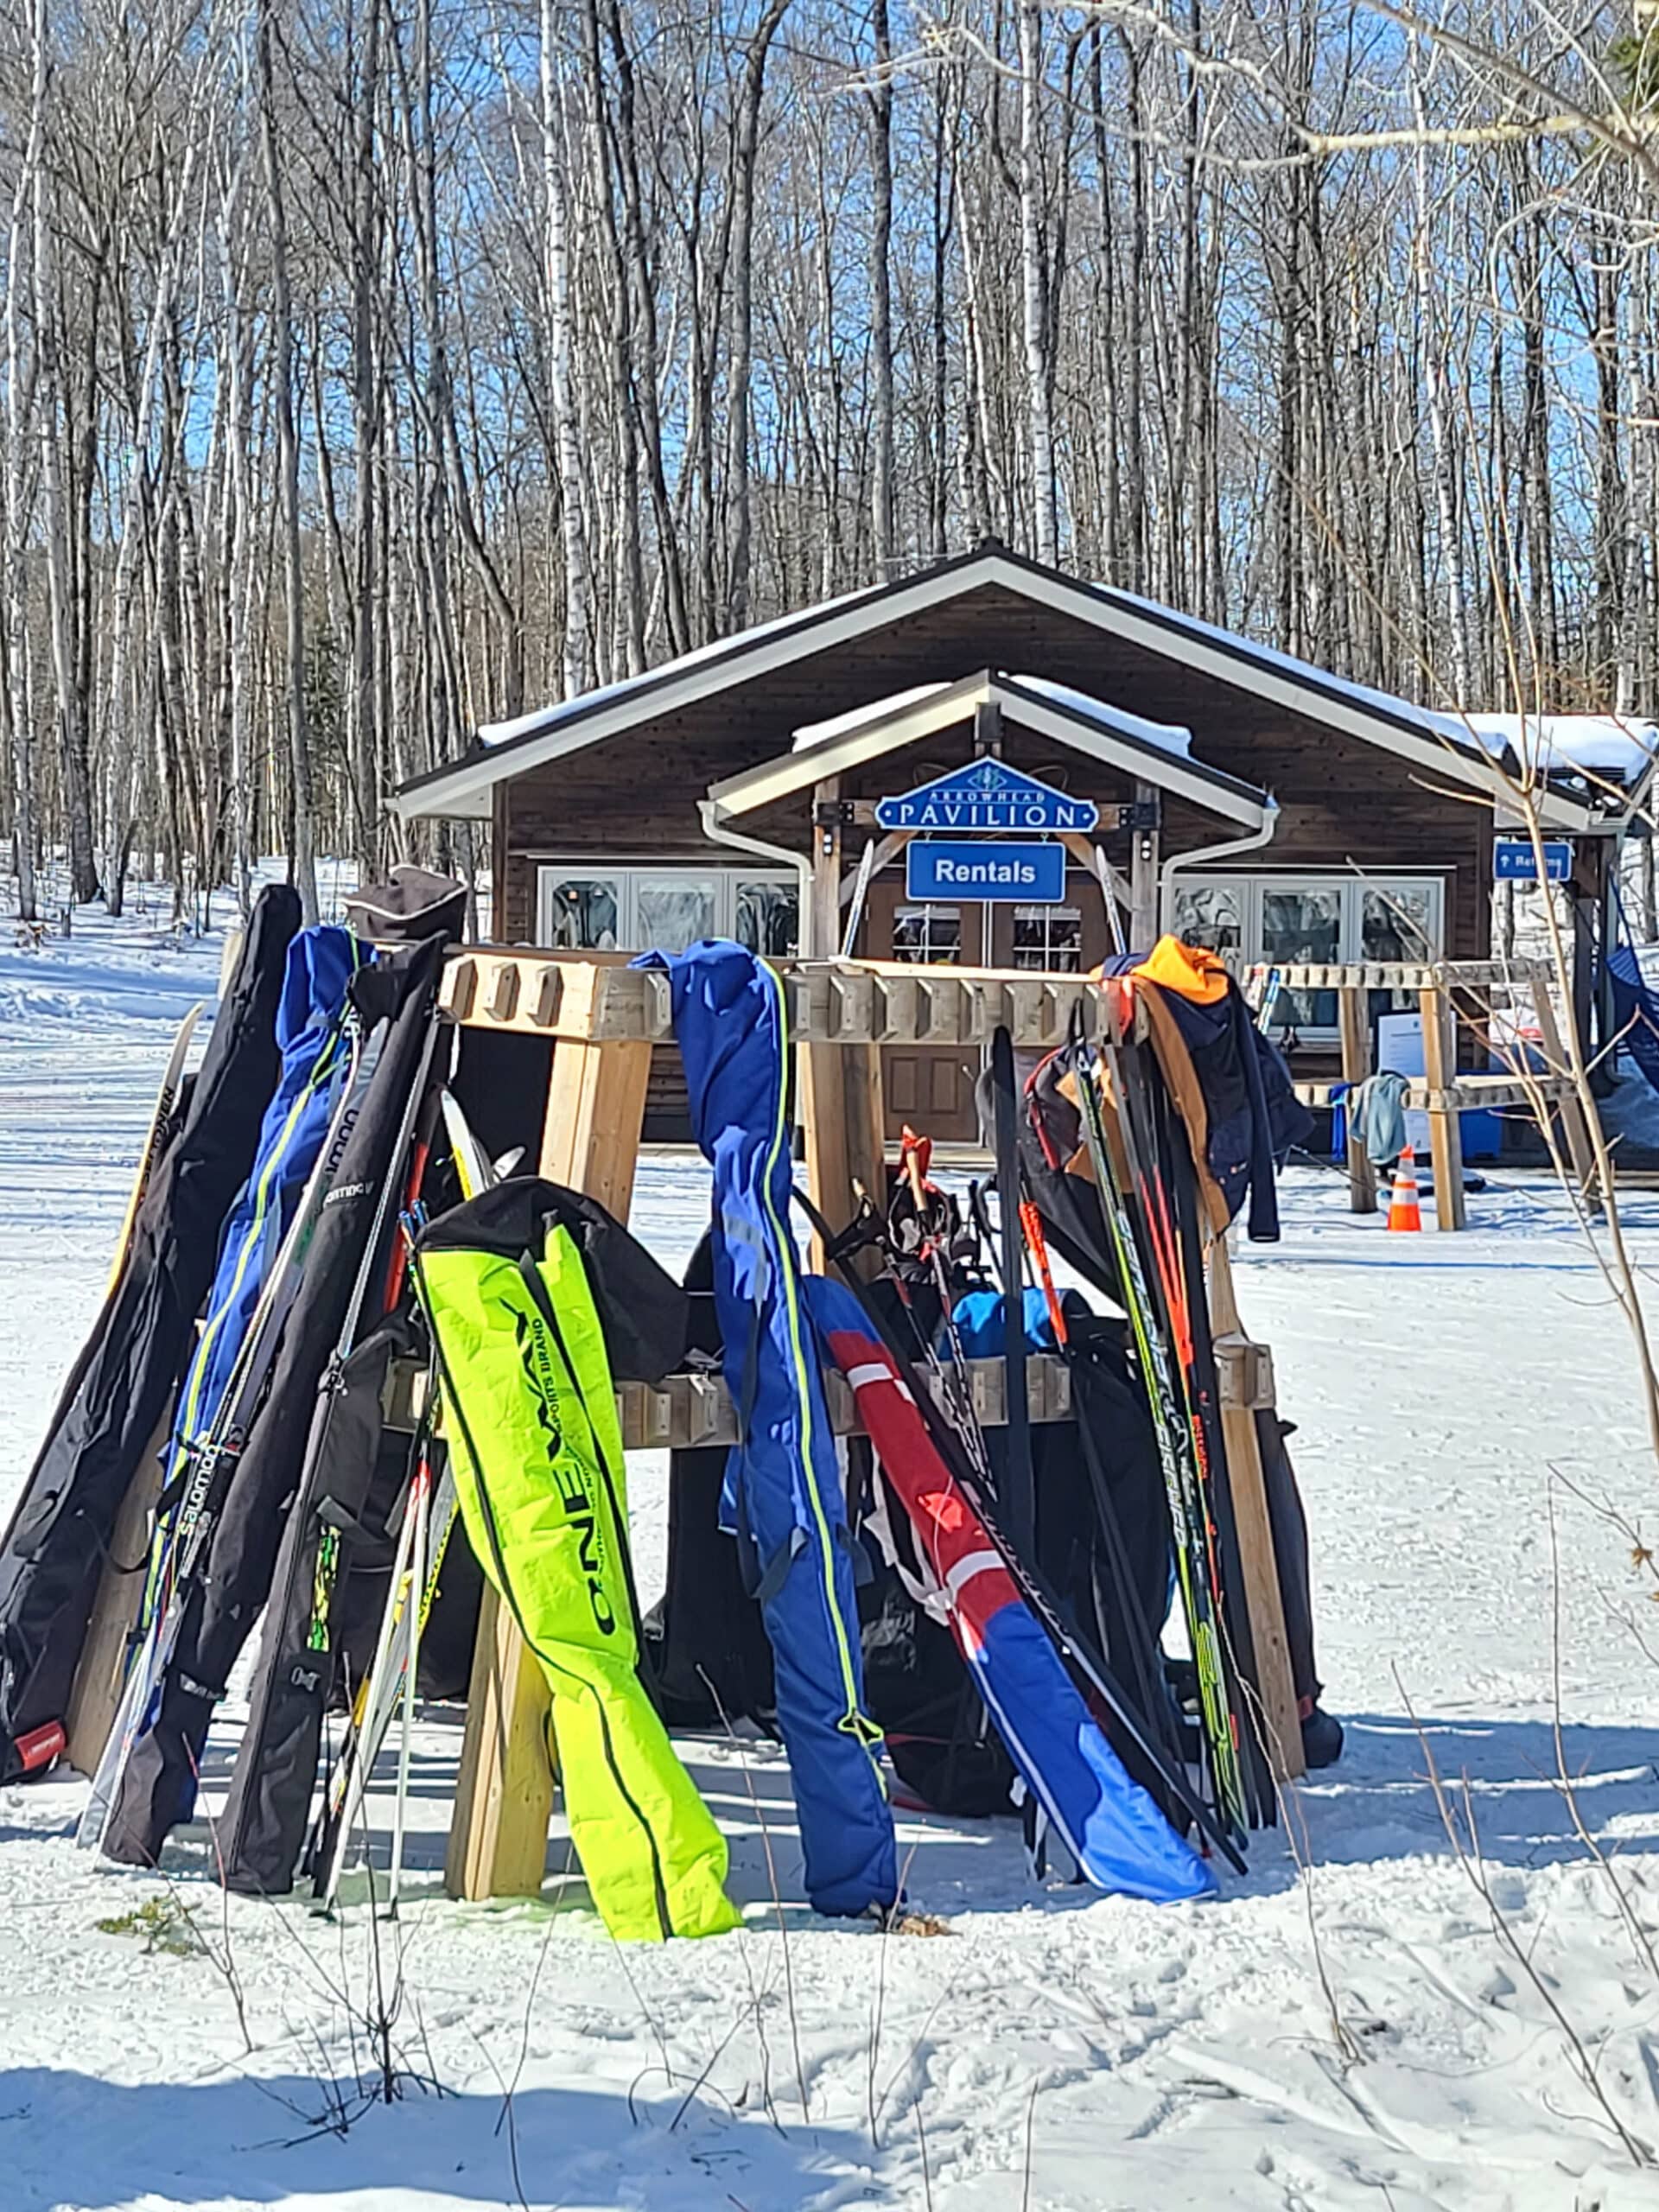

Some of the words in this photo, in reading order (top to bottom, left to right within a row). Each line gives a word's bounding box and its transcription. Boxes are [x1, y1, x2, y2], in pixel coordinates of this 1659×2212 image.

[899, 804, 1075, 827] PAVILION
[936, 859, 1036, 884] Rentals
[532, 1318, 551, 1373] BRAND
[179, 1444, 220, 1535] salomon
